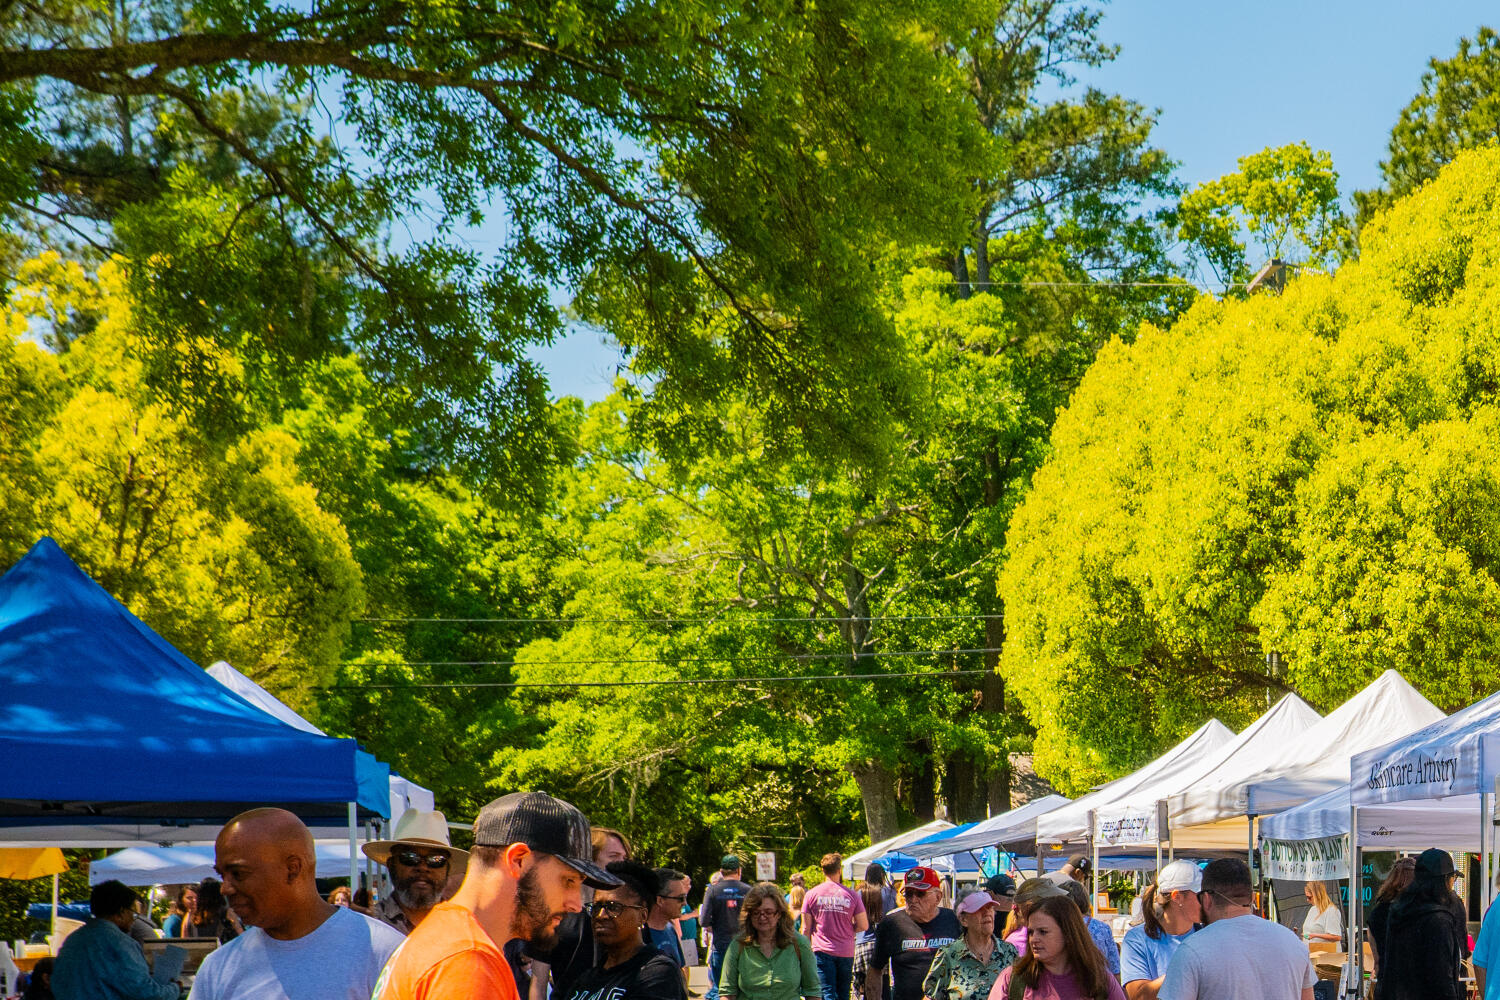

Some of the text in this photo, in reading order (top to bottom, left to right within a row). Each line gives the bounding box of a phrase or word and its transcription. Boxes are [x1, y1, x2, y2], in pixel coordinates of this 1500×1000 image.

[1366, 751, 1458, 790] Skincare Artistry
[1271, 841, 1298, 861] BOTTOM
[1319, 837, 1343, 860] PLANT
[927, 937, 956, 948] DAKOT
